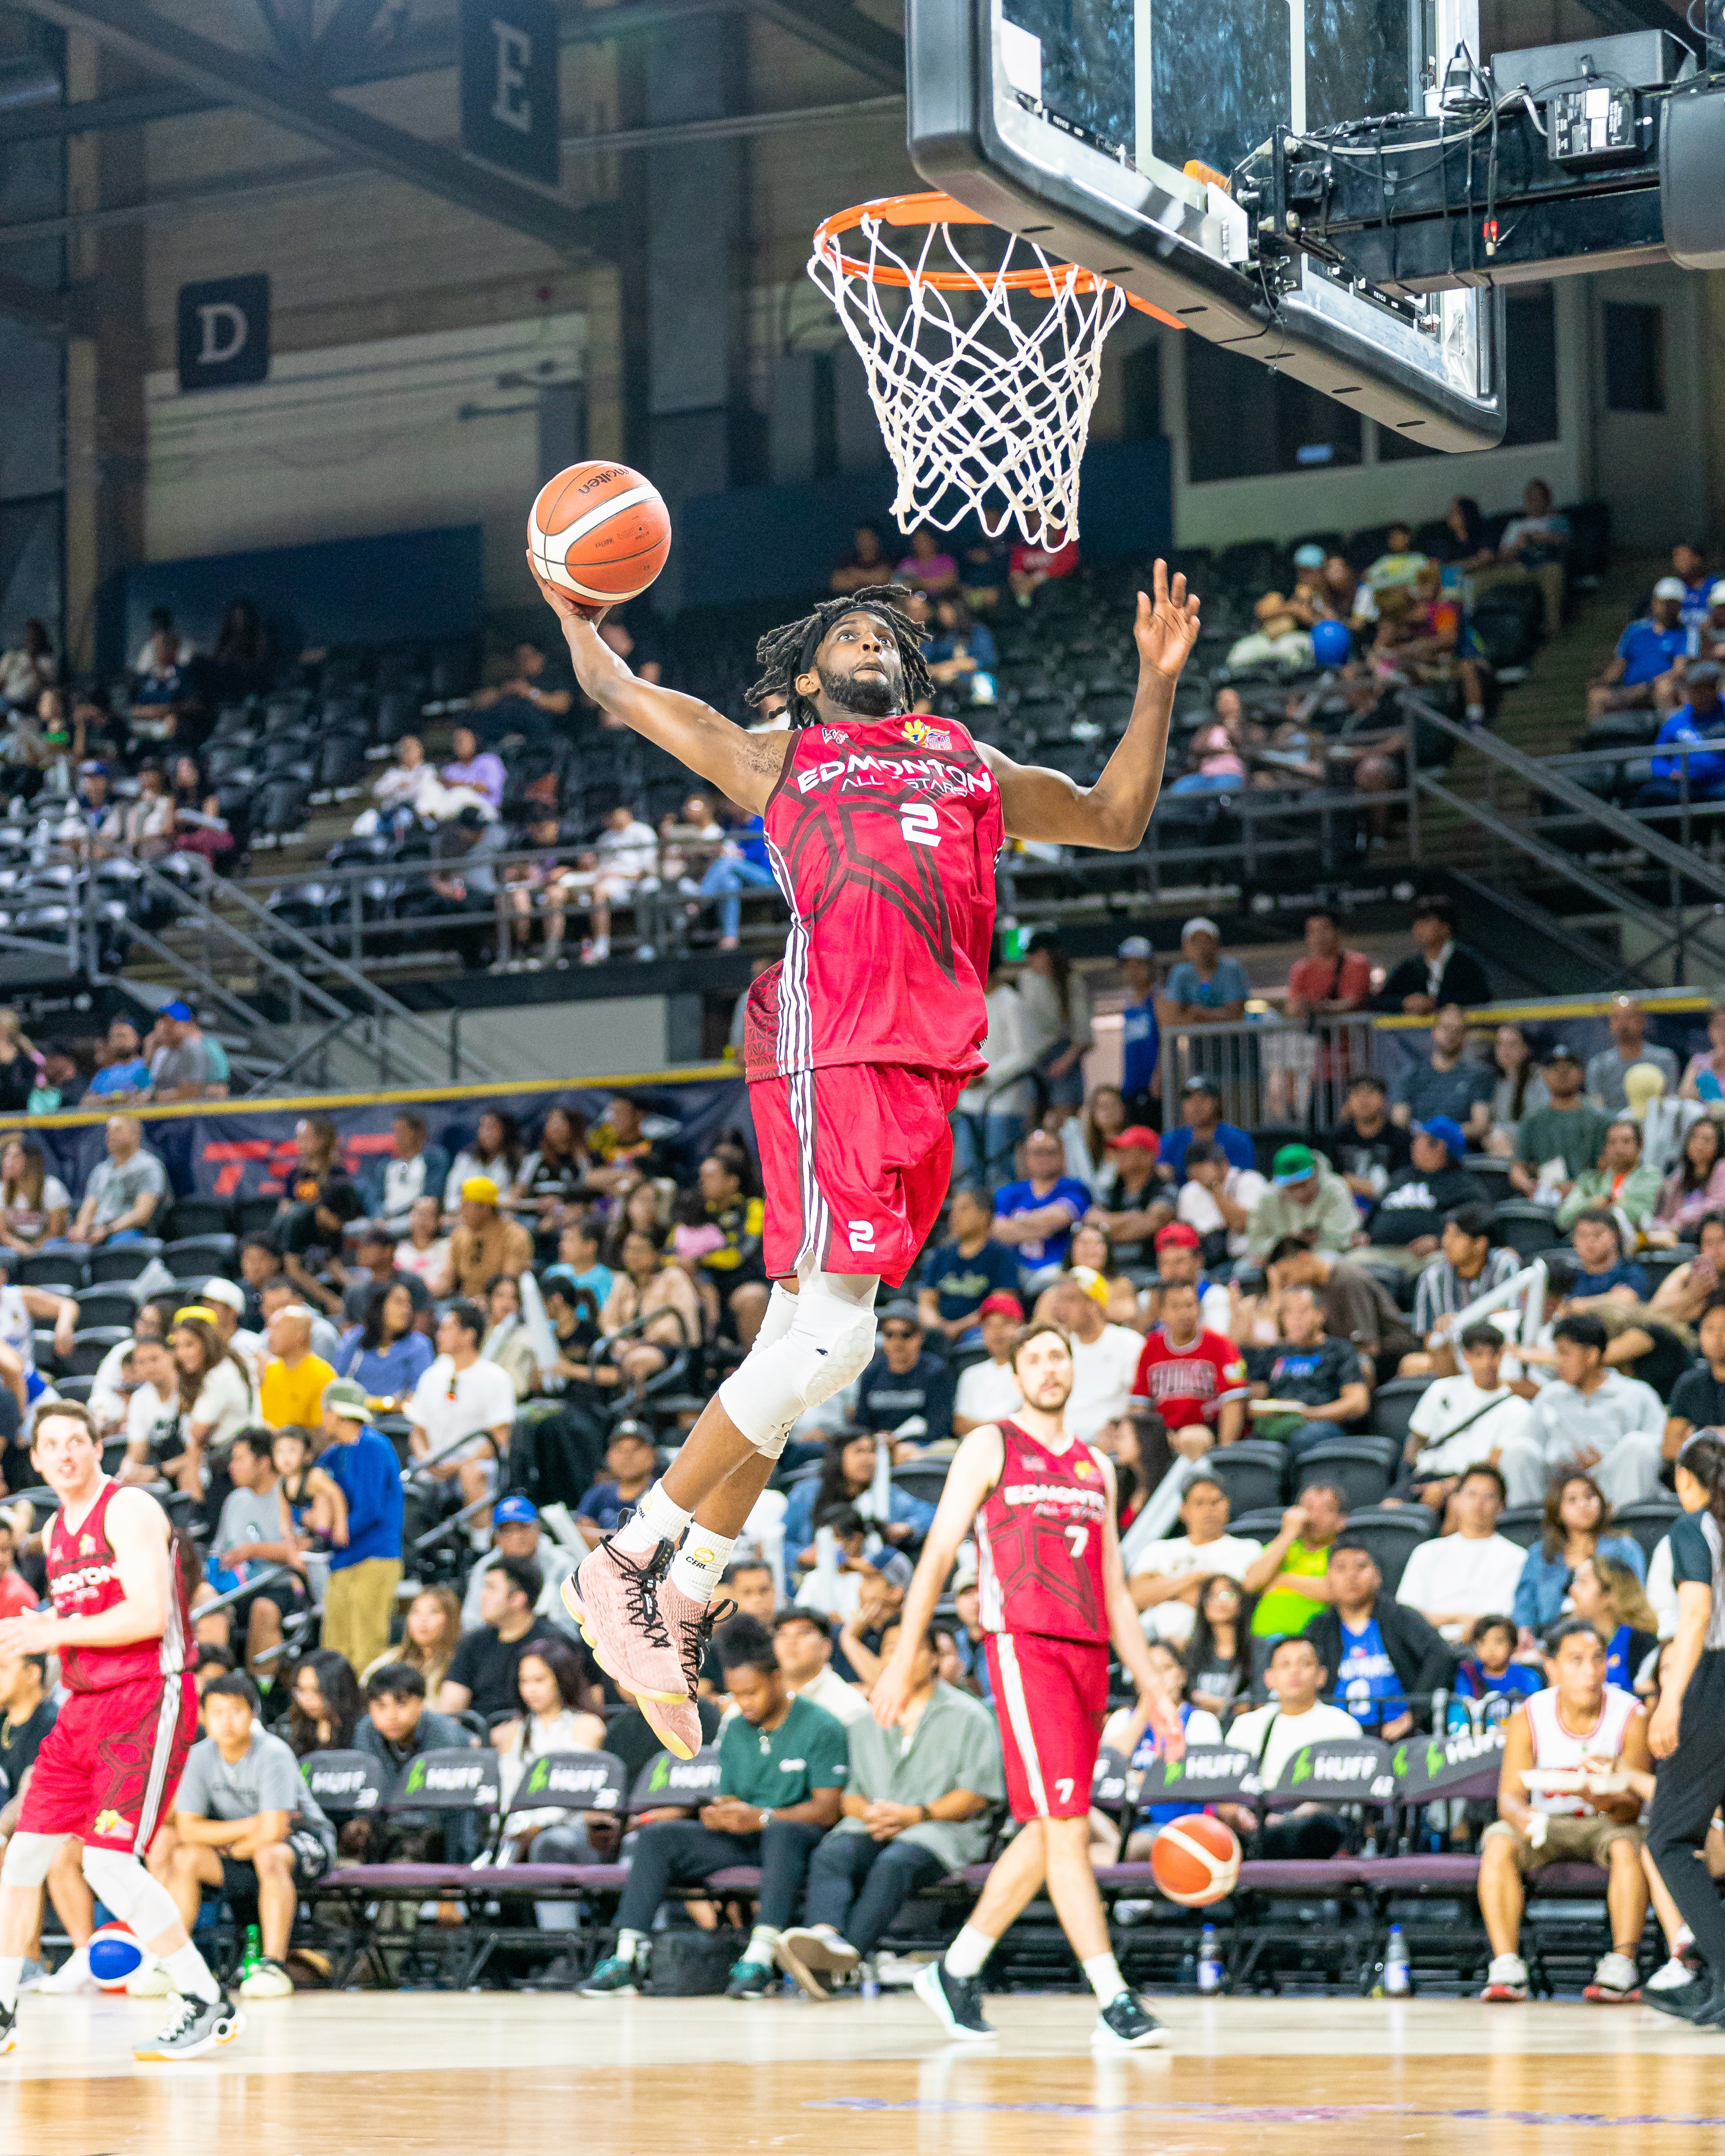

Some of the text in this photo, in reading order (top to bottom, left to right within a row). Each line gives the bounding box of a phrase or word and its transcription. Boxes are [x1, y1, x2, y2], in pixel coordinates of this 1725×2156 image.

[493, 17, 533, 134] E
[196, 303, 249, 366] D
[578, 468, 630, 495] molten
[797, 754, 992, 795] EDMONTON
[841, 774, 885, 792] ALL
[899, 803, 942, 848] 2
[848, 1220, 876, 1253] 2
[1064, 1526, 1089, 1558] 7
[426, 1767, 484, 1790] HUFF
[1185, 1754, 1249, 1779] HUFF
[1313, 1756, 1378, 1781] HUFF
[311, 1770, 366, 1794] HUFF
[549, 1769, 608, 1791] HUFF
[1054, 1778, 1075, 1804] 7
